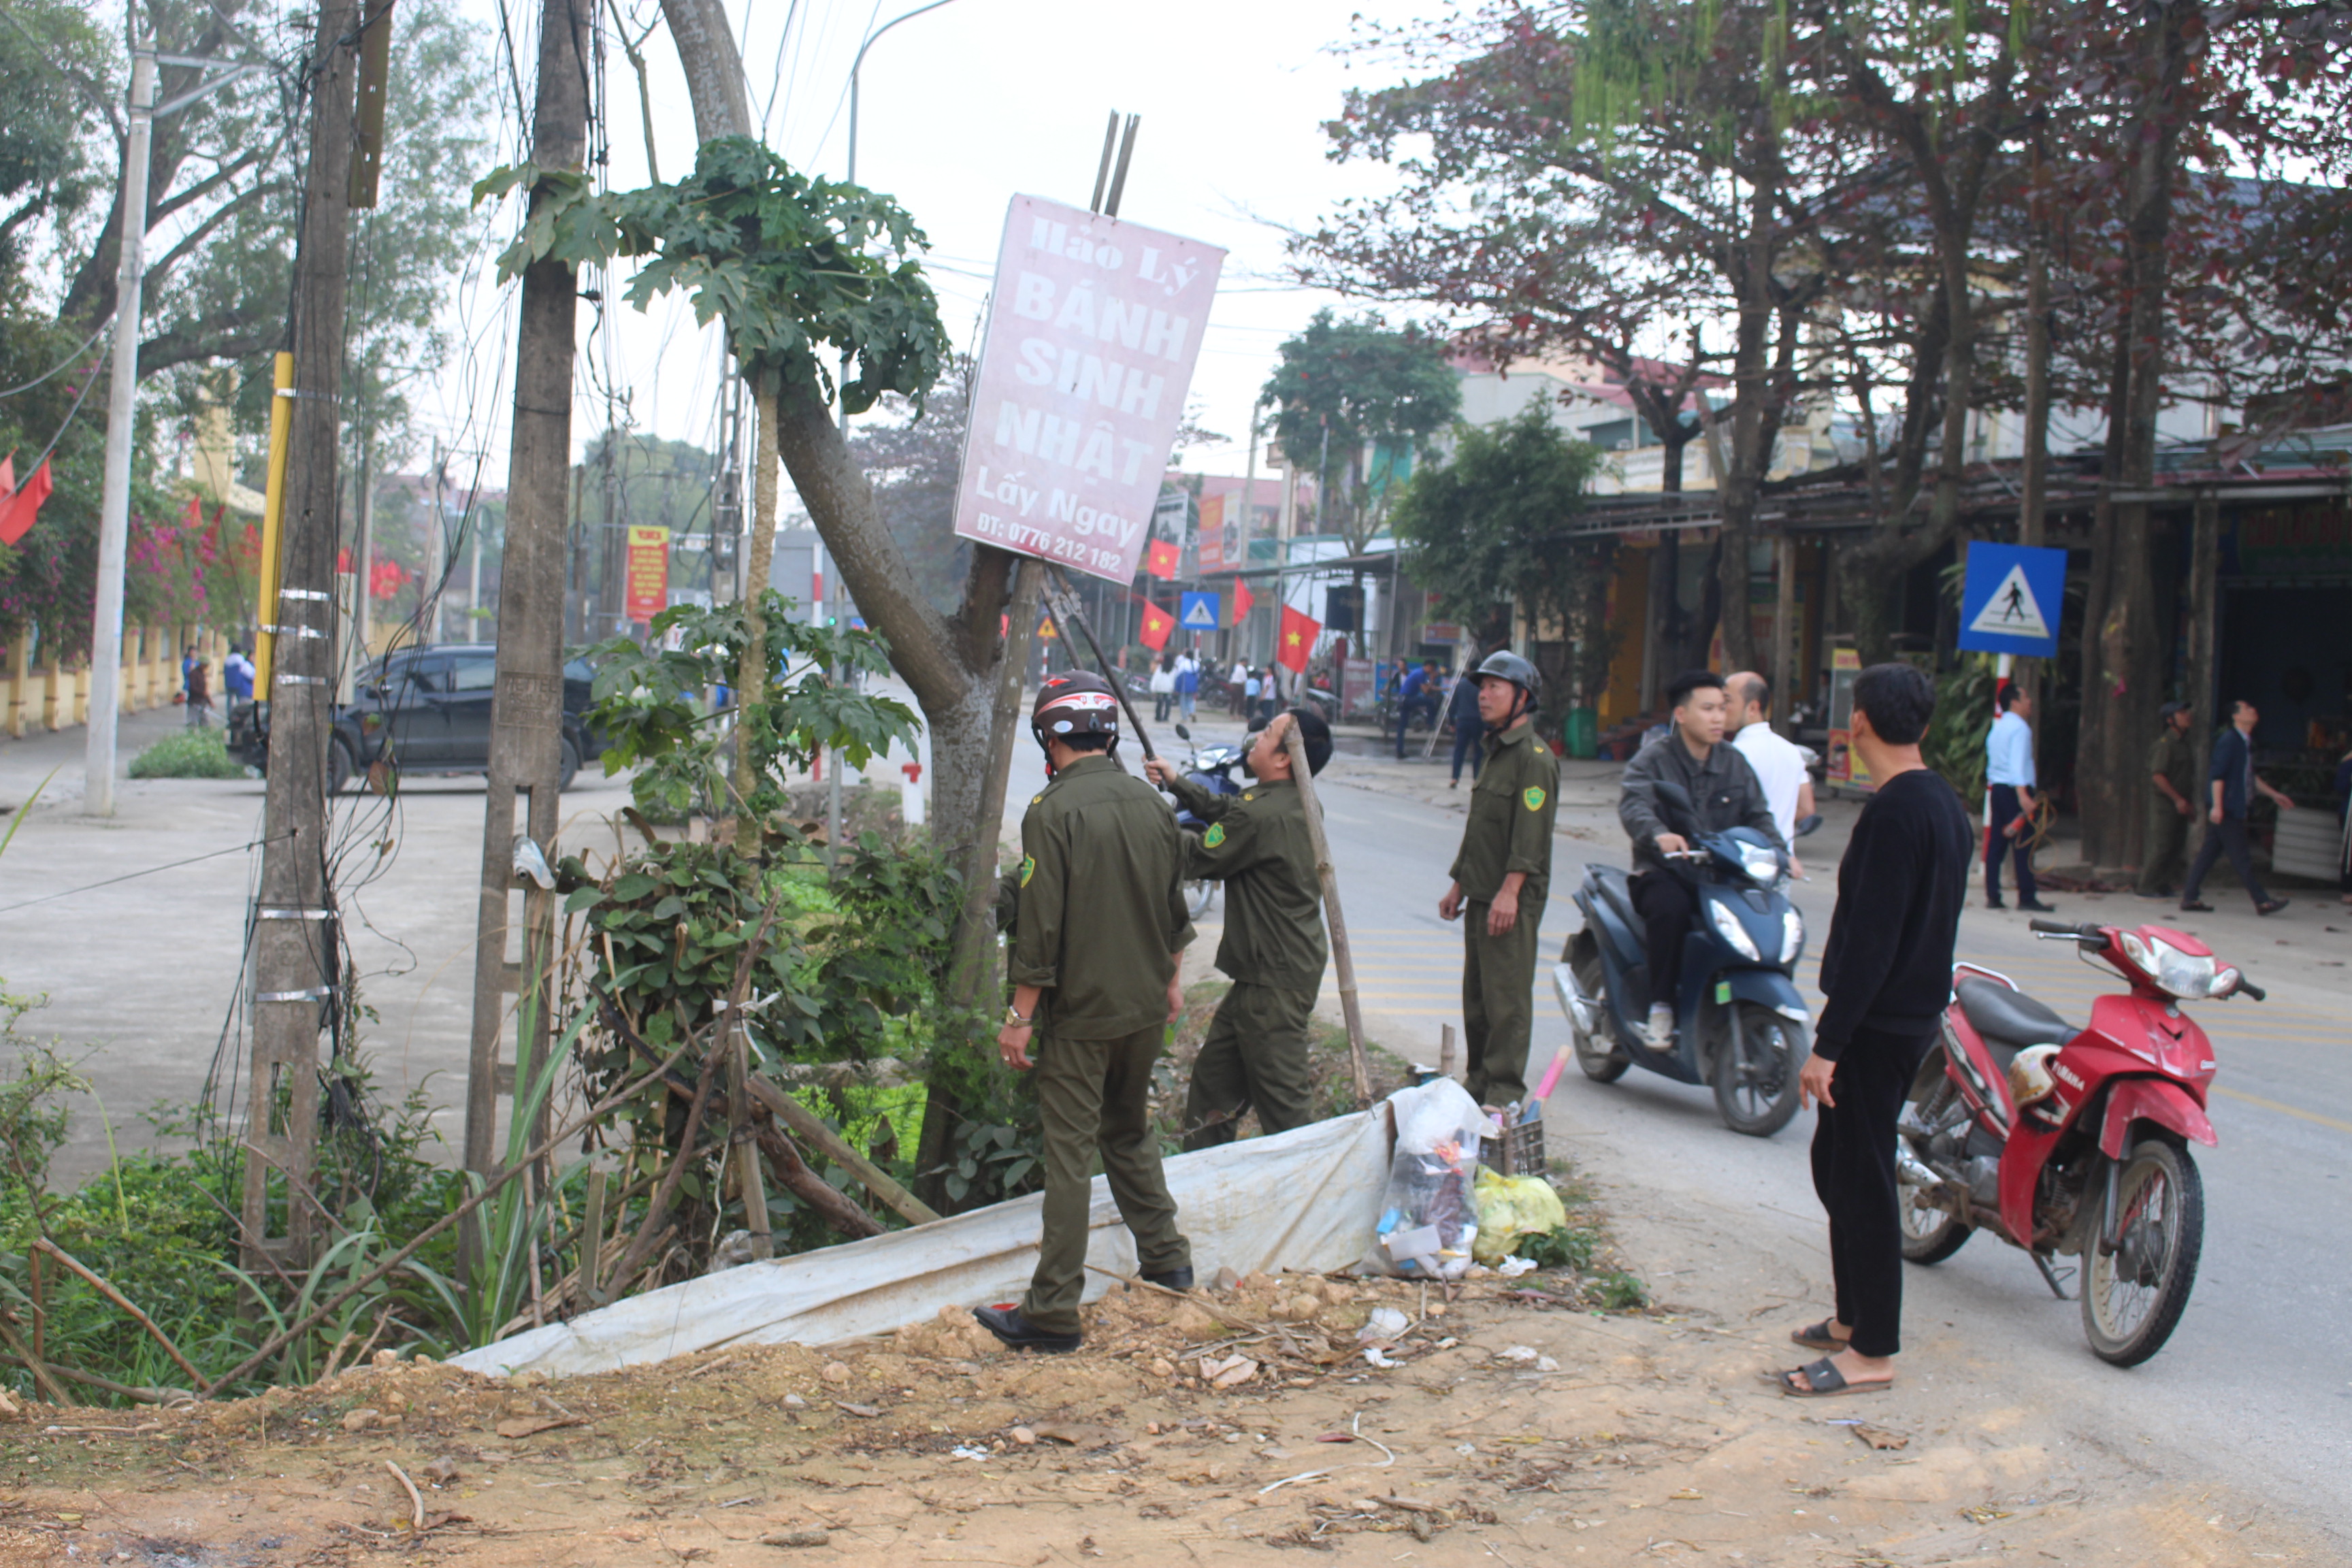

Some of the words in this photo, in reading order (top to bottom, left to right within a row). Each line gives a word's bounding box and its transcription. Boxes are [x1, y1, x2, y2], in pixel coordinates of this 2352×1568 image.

[1137, 245, 1200, 297] Lý
[1014, 270, 1190, 363] BÁNH
[1015, 338, 1166, 421] SINH
[994, 399, 1155, 487] NHẬT
[976, 466, 1040, 517] Lấy
[1049, 487, 1140, 549] Ngay
[977, 512, 1004, 538] ĐT:
[1009, 521, 1051, 551] 0776
[1054, 536, 1087, 562] 212
[1091, 547, 1122, 574] 182
